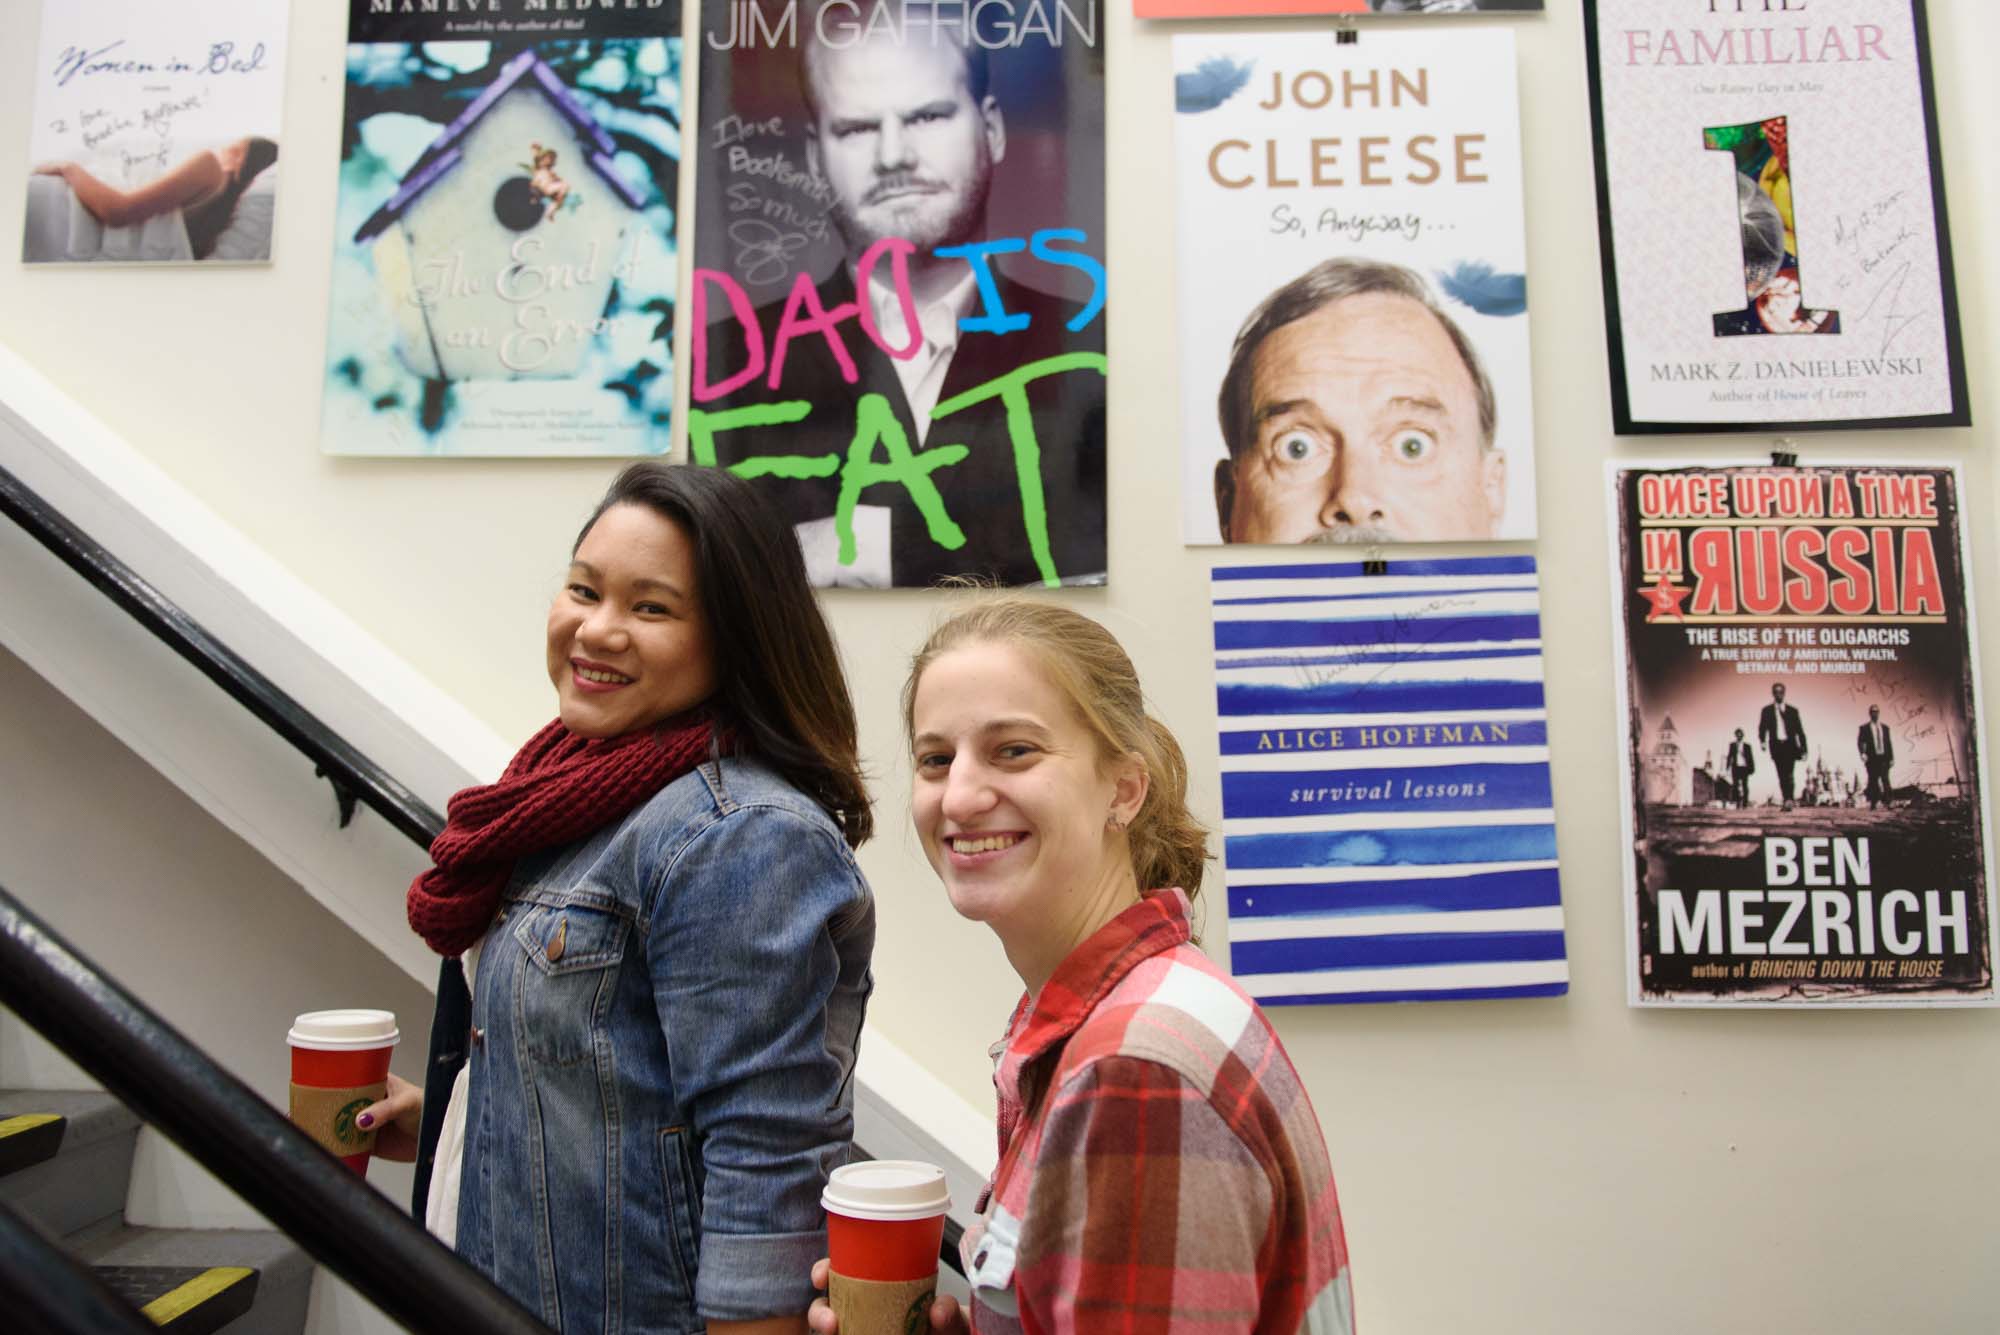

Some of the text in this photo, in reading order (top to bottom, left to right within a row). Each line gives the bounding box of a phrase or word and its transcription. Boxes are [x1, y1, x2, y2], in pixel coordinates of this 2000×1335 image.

[707, 0, 1097, 51] JIM GAFFIGAN
[1624, 24, 1894, 67] FAMILIAR
[53, 40, 266, 87] Women in Bed
[1258, 68, 1430, 111] JOHN
[1208, 133, 1489, 190] CLEESE
[1270, 203, 1307, 239] So,
[1703, 115, 1841, 337] 1
[497, 234, 599, 304] End
[933, 228, 1108, 334] IS
[1650, 356, 1924, 383] MARK Z. DANIELEWSKI
[1709, 389, 1754, 402] Author
[688, 352, 1108, 589] FAT
[1829, 473, 1854, 519] A
[1855, 472, 1939, 519] TIME
[1685, 627, 1911, 646] THE RISE OF THE OLIGARCHS
[1701, 648, 1711, 662] A
[1712, 648, 1740, 662] TRUE
[1742, 648, 1776, 662] STORY
[1778, 648, 1793, 661] OF
[1795, 662, 1818, 674] AND
[1819, 662, 1867, 674] MURDER
[1257, 723, 1512, 751] ALICE HOFFMAN
[1290, 778, 1487, 804] survival lessons
[1764, 837, 1872, 887] BEN
[1657, 889, 1970, 956] MEZRICH
[1692, 959, 1945, 979] author of BRINGING DOWN THE HOUSE
